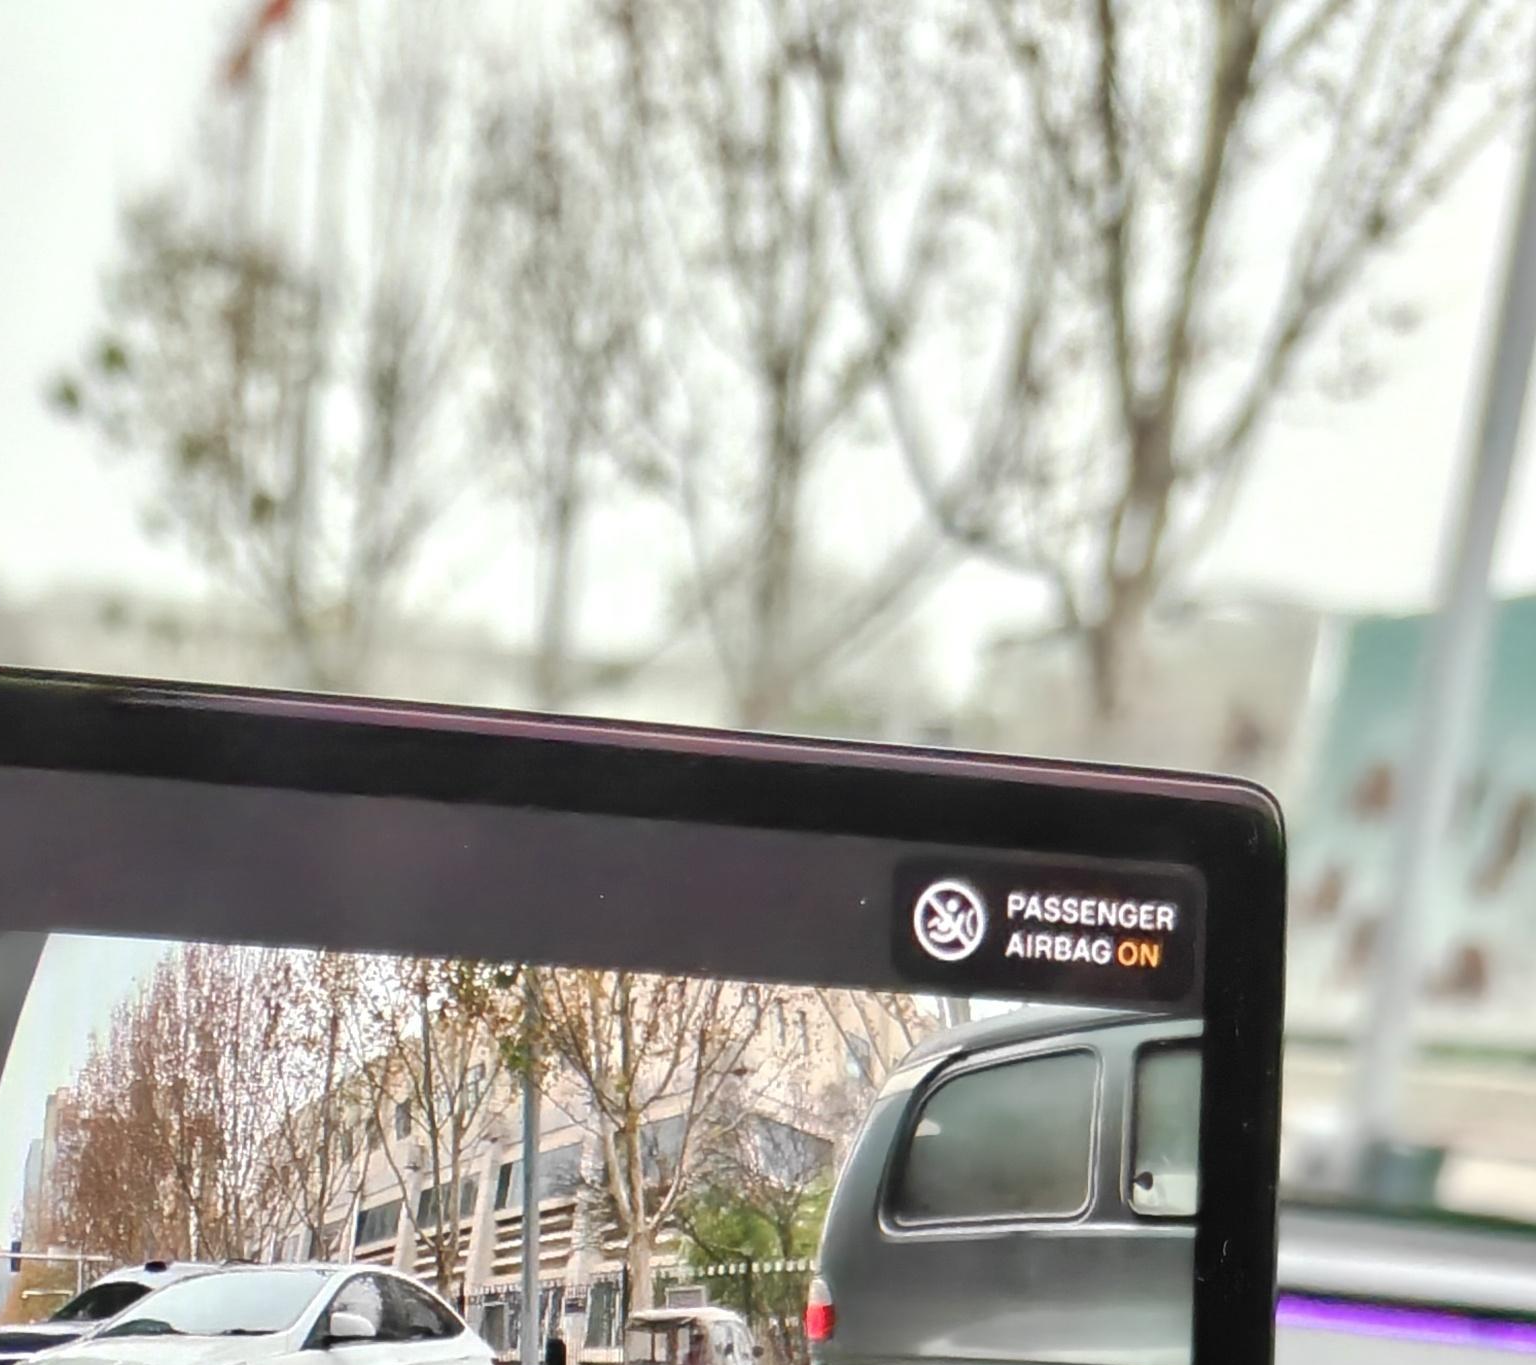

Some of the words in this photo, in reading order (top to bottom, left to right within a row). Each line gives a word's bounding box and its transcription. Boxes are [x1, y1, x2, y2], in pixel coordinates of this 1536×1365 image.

[1007, 891, 1176, 932] PASSENGER
[1005, 932, 1112, 965] AIRBAG
[1116, 939, 1160, 968] ON
